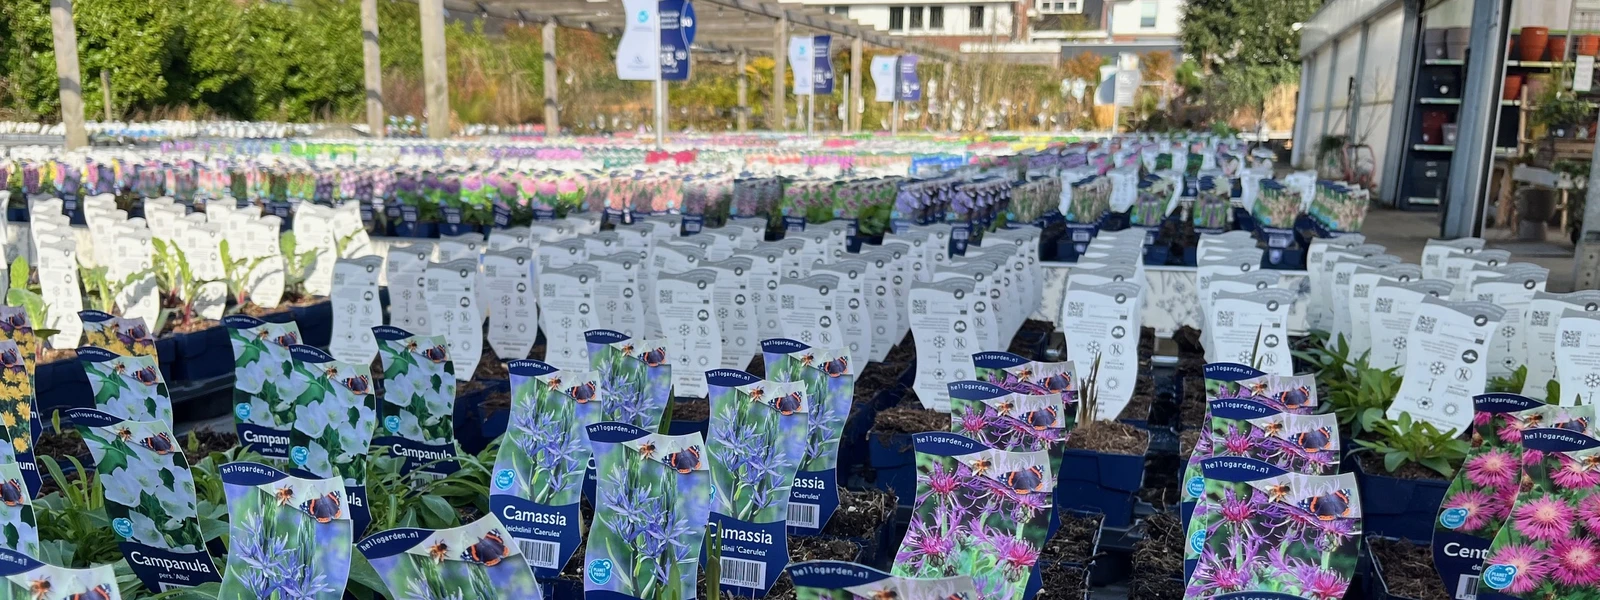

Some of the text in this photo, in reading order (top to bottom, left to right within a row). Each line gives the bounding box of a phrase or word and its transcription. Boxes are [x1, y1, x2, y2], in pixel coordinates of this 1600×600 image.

[226, 317, 257, 325] hellogarden.nl
[374, 327, 405, 336] hellogarden.nl
[586, 331, 623, 339] hellogarden.nl
[763, 340, 802, 348] hellogarden.nl
[78, 349, 111, 358] hellogarden.nl
[290, 346, 326, 359] hellogarden.nl
[975, 354, 1019, 363] hellogarden.nl
[510, 360, 549, 371] hellogarden.nl
[1206, 365, 1253, 376] hellogarden.nl
[708, 370, 751, 381] hellogarden.nl
[950, 382, 999, 394] hellogarden.nl
[1212, 402, 1266, 414] hellogarden.nl
[1475, 397, 1529, 407] hellogarden.nl
[70, 412, 112, 422] hellogarden.nl
[589, 423, 638, 435] hellogarden.nl
[916, 435, 974, 449] hellogarden.nl
[1524, 431, 1587, 446] hellogarden.nl
[393, 443, 454, 462] Campanula
[222, 464, 275, 478] hellogarden.nl
[1205, 461, 1269, 474] hellogarden.nl
[503, 505, 567, 526] Camassia
[533, 527, 562, 537] 'Caerulea'
[360, 531, 419, 552] hellogarden.nl
[736, 545, 768, 557] 'Caerulea'
[130, 551, 211, 573] Campanula
[792, 565, 869, 579] hellogarden.nl
